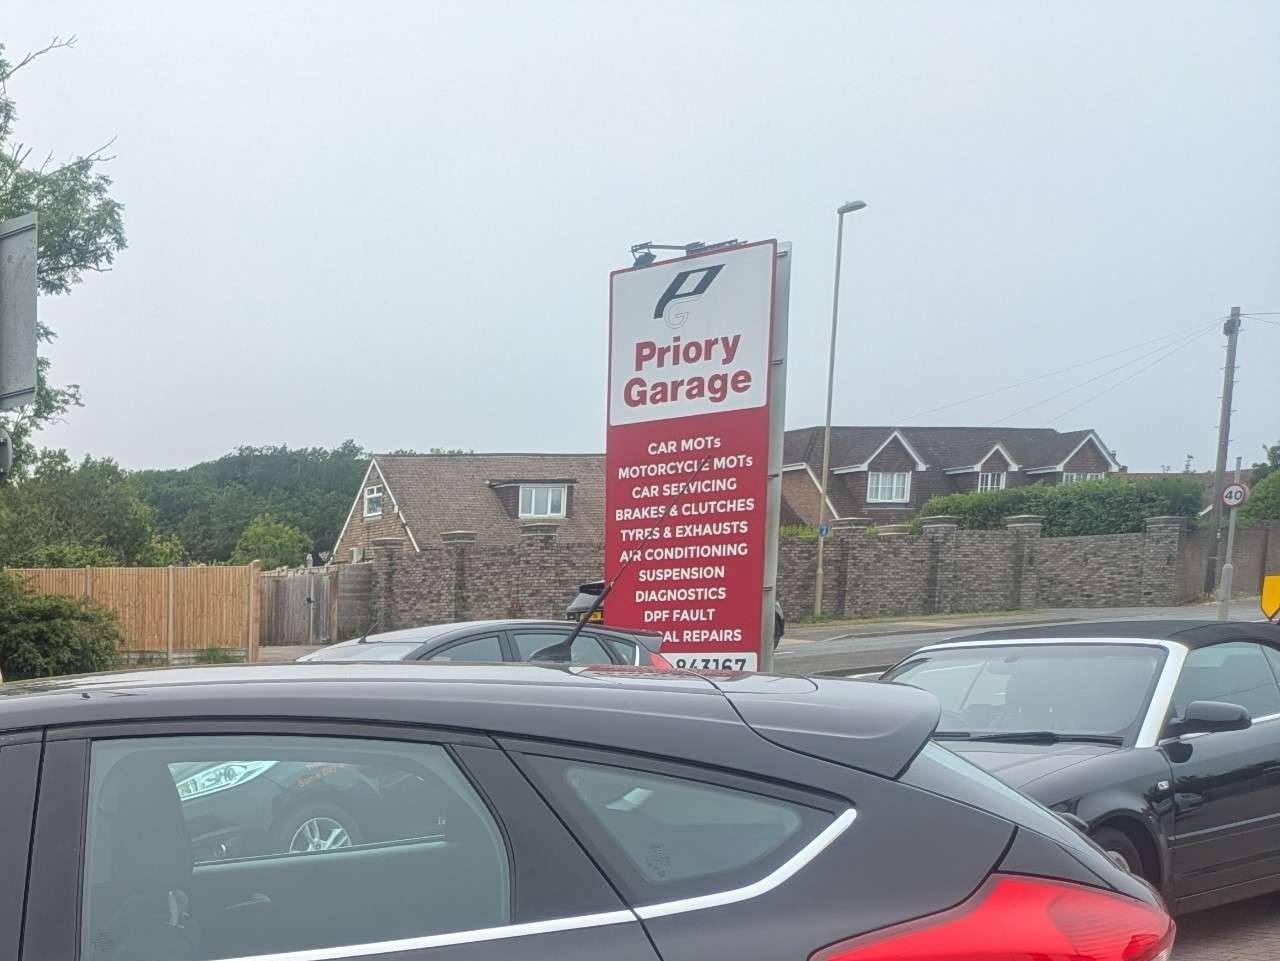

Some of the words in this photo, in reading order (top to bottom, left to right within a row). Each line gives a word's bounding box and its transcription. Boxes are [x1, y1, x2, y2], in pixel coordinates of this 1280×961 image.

[634, 334, 741, 371] Priory
[623, 370, 752, 407] Garage
[647, 441, 677, 455] CAR
[681, 436, 721, 452] MOTs
[713, 455, 753, 470] MOTs
[632, 485, 659, 498] CAR
[662, 478, 737, 496] SERVICING
[1224, 490, 1242, 501] 40
[615, 505, 666, 521] BRAKES
[669, 504, 678, 517] &
[681, 498, 755, 516] CLUTCHES
[620, 527, 660, 541] TYRES
[663, 526, 672, 539] &
[675, 521, 748, 538] EXHAUSTS
[619, 549, 641, 563] AIR
[644, 543, 748, 561] CONDITIONING
[639, 565, 725, 582] SUSPENSION
[635, 587, 726, 603] DIAGNOSTICS
[644, 610, 669, 622] DPF
[672, 608, 716, 621] FAULT
[683, 629, 742, 642] REPAIRS
